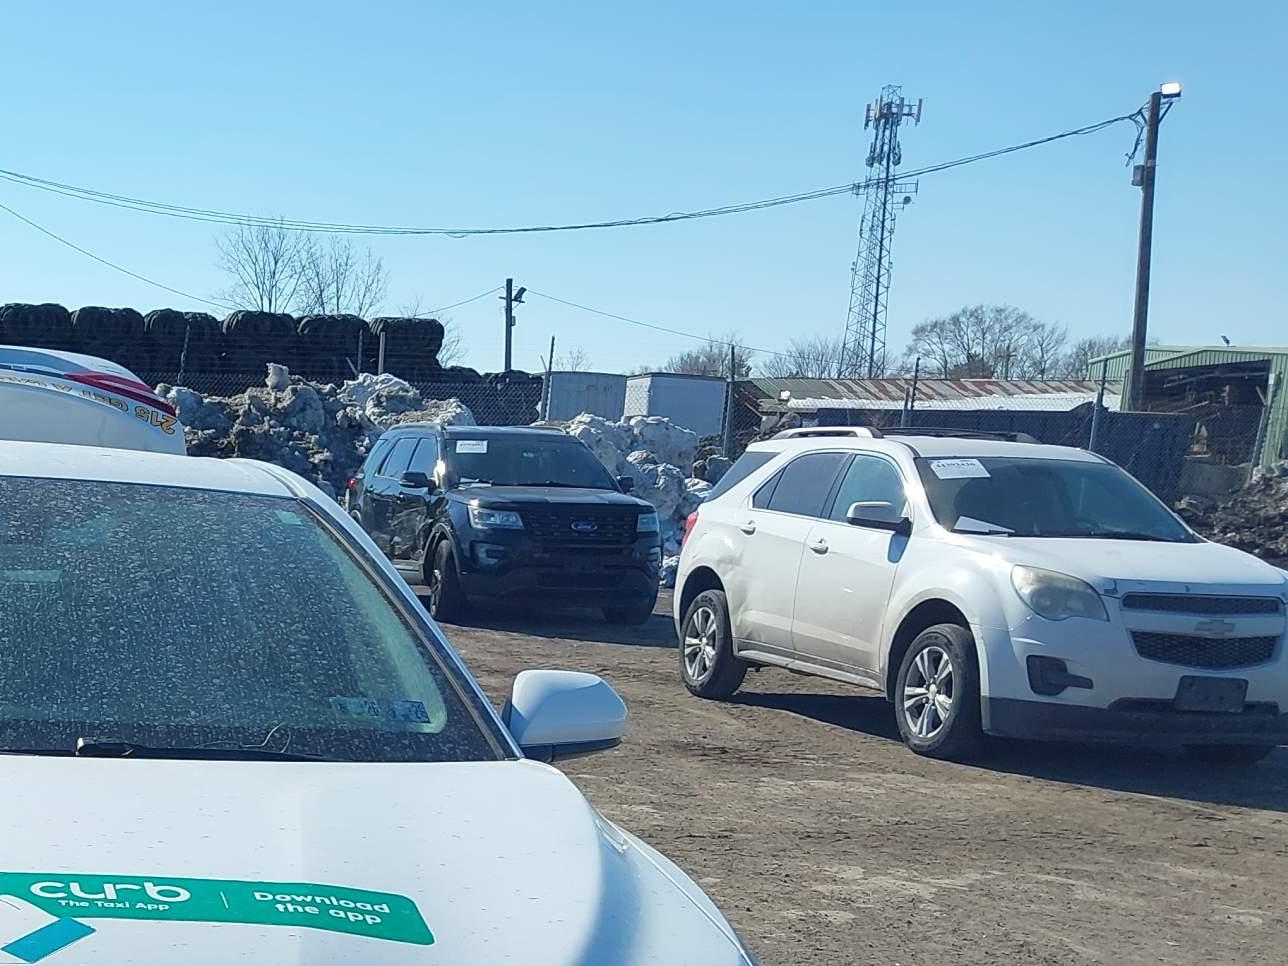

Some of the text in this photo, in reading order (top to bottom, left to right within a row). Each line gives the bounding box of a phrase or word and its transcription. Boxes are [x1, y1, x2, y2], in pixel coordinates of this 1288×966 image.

[135, 406, 177, 435] 215
[29, 881, 192, 903] curb
[253, 890, 391, 914] Download
[58, 900, 170, 912] The Taxi App
[275, 902, 382, 925] the app
